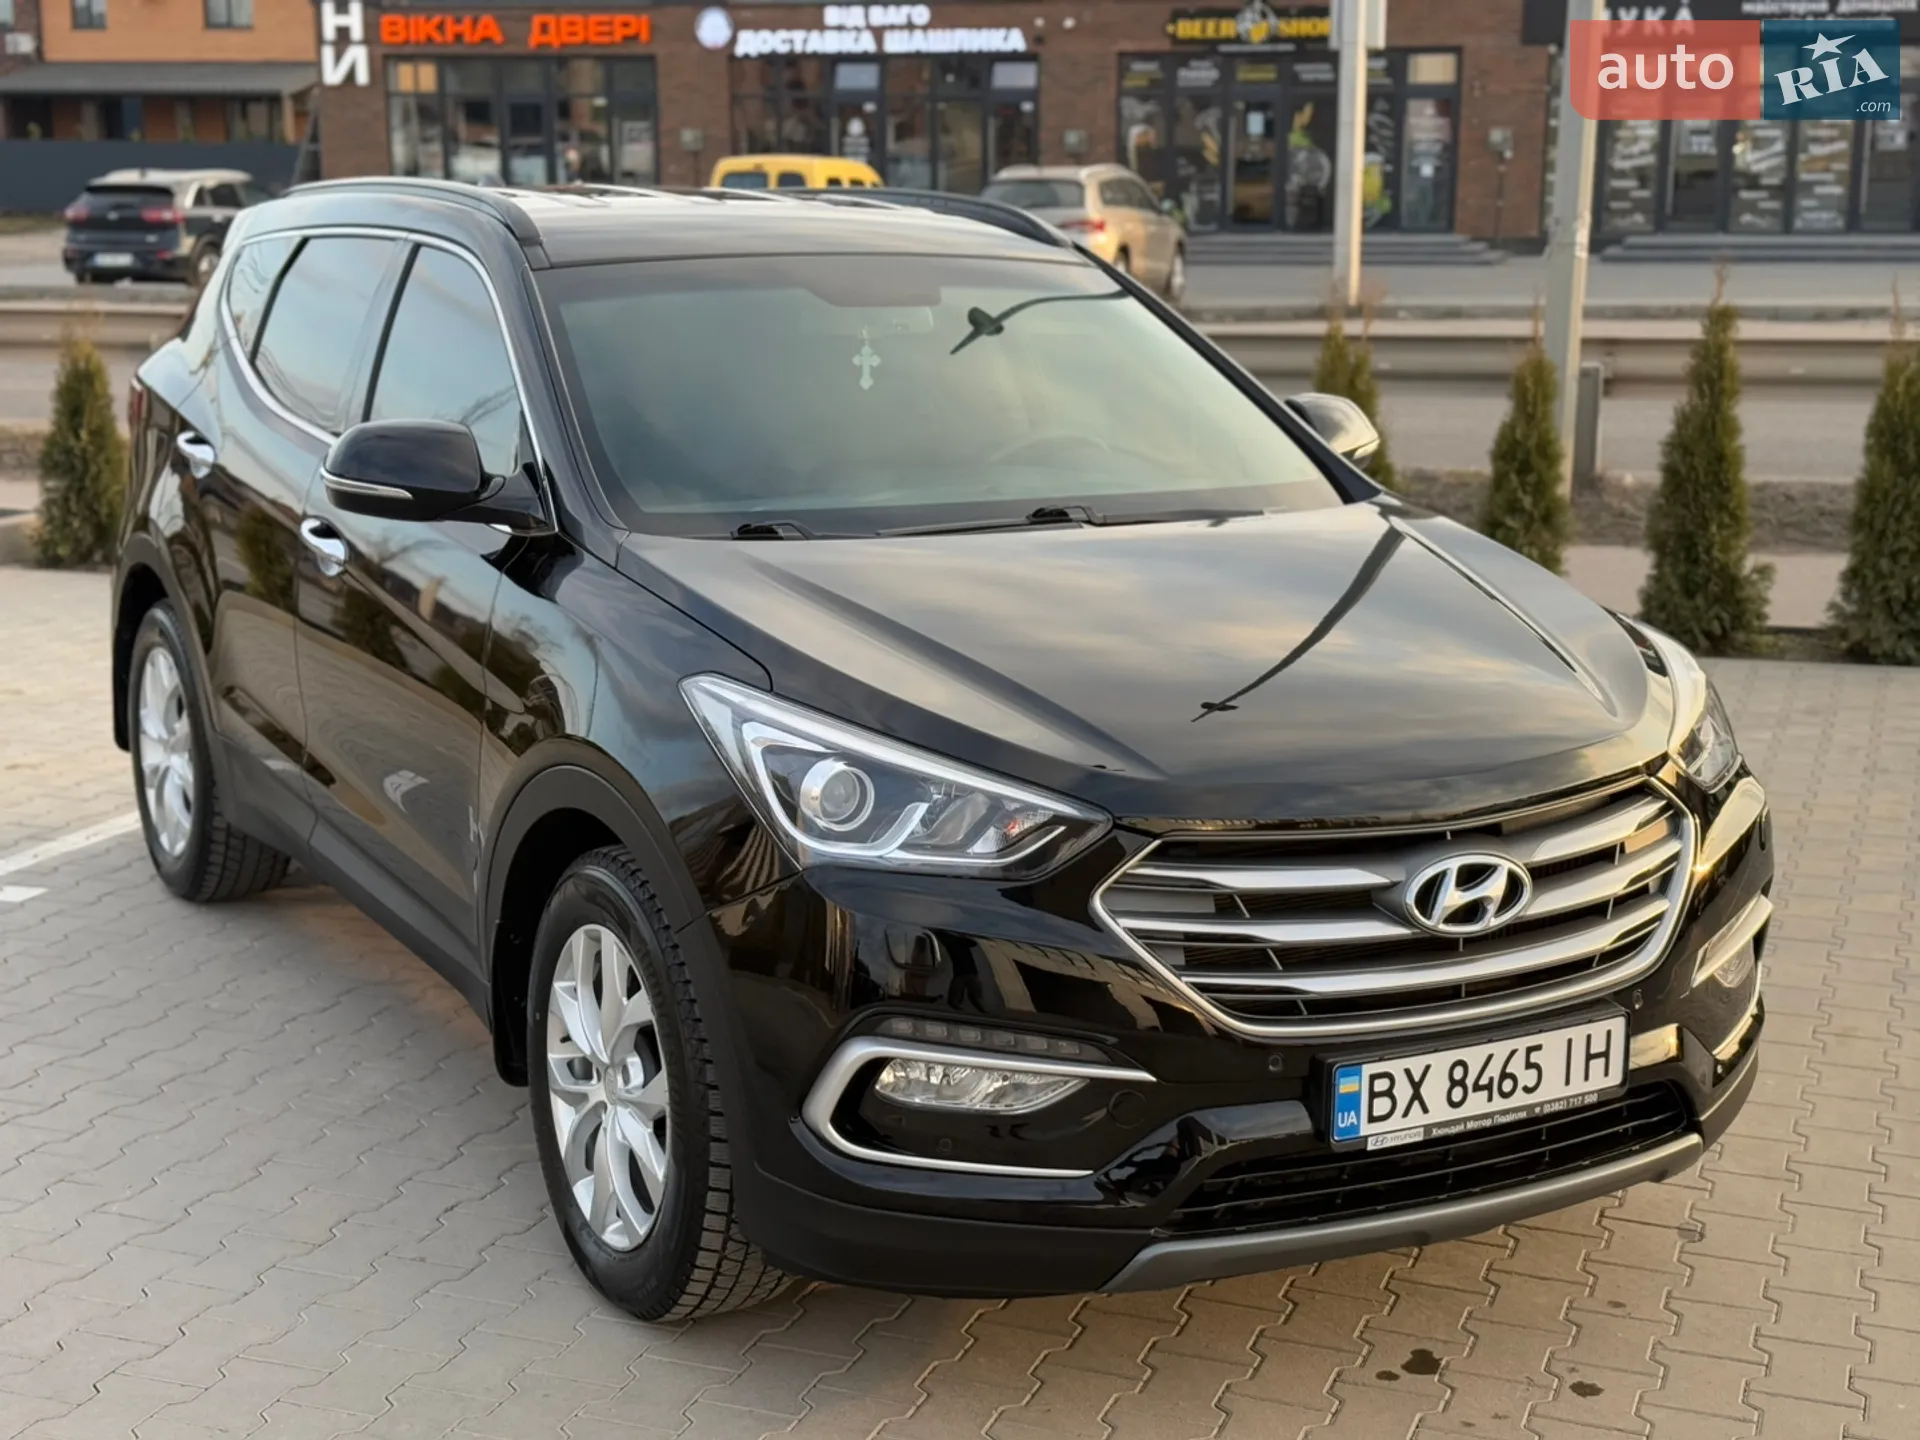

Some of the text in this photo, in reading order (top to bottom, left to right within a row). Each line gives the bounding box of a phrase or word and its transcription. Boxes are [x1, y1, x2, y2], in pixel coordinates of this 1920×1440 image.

[380, 14, 651, 49] ВІКНА ДВЕРІ
[1175, 17, 1238, 40] BEER
[734, 28, 1027, 58] ДОСТАВКА ШАШЛИКА
[1367, 1029, 1612, 1125] BX 8465 IH
[1569, 1097, 1583, 1108] 717
[1337, 1111, 1358, 1128] UA
[1466, 1115, 1492, 1130] Мотор
